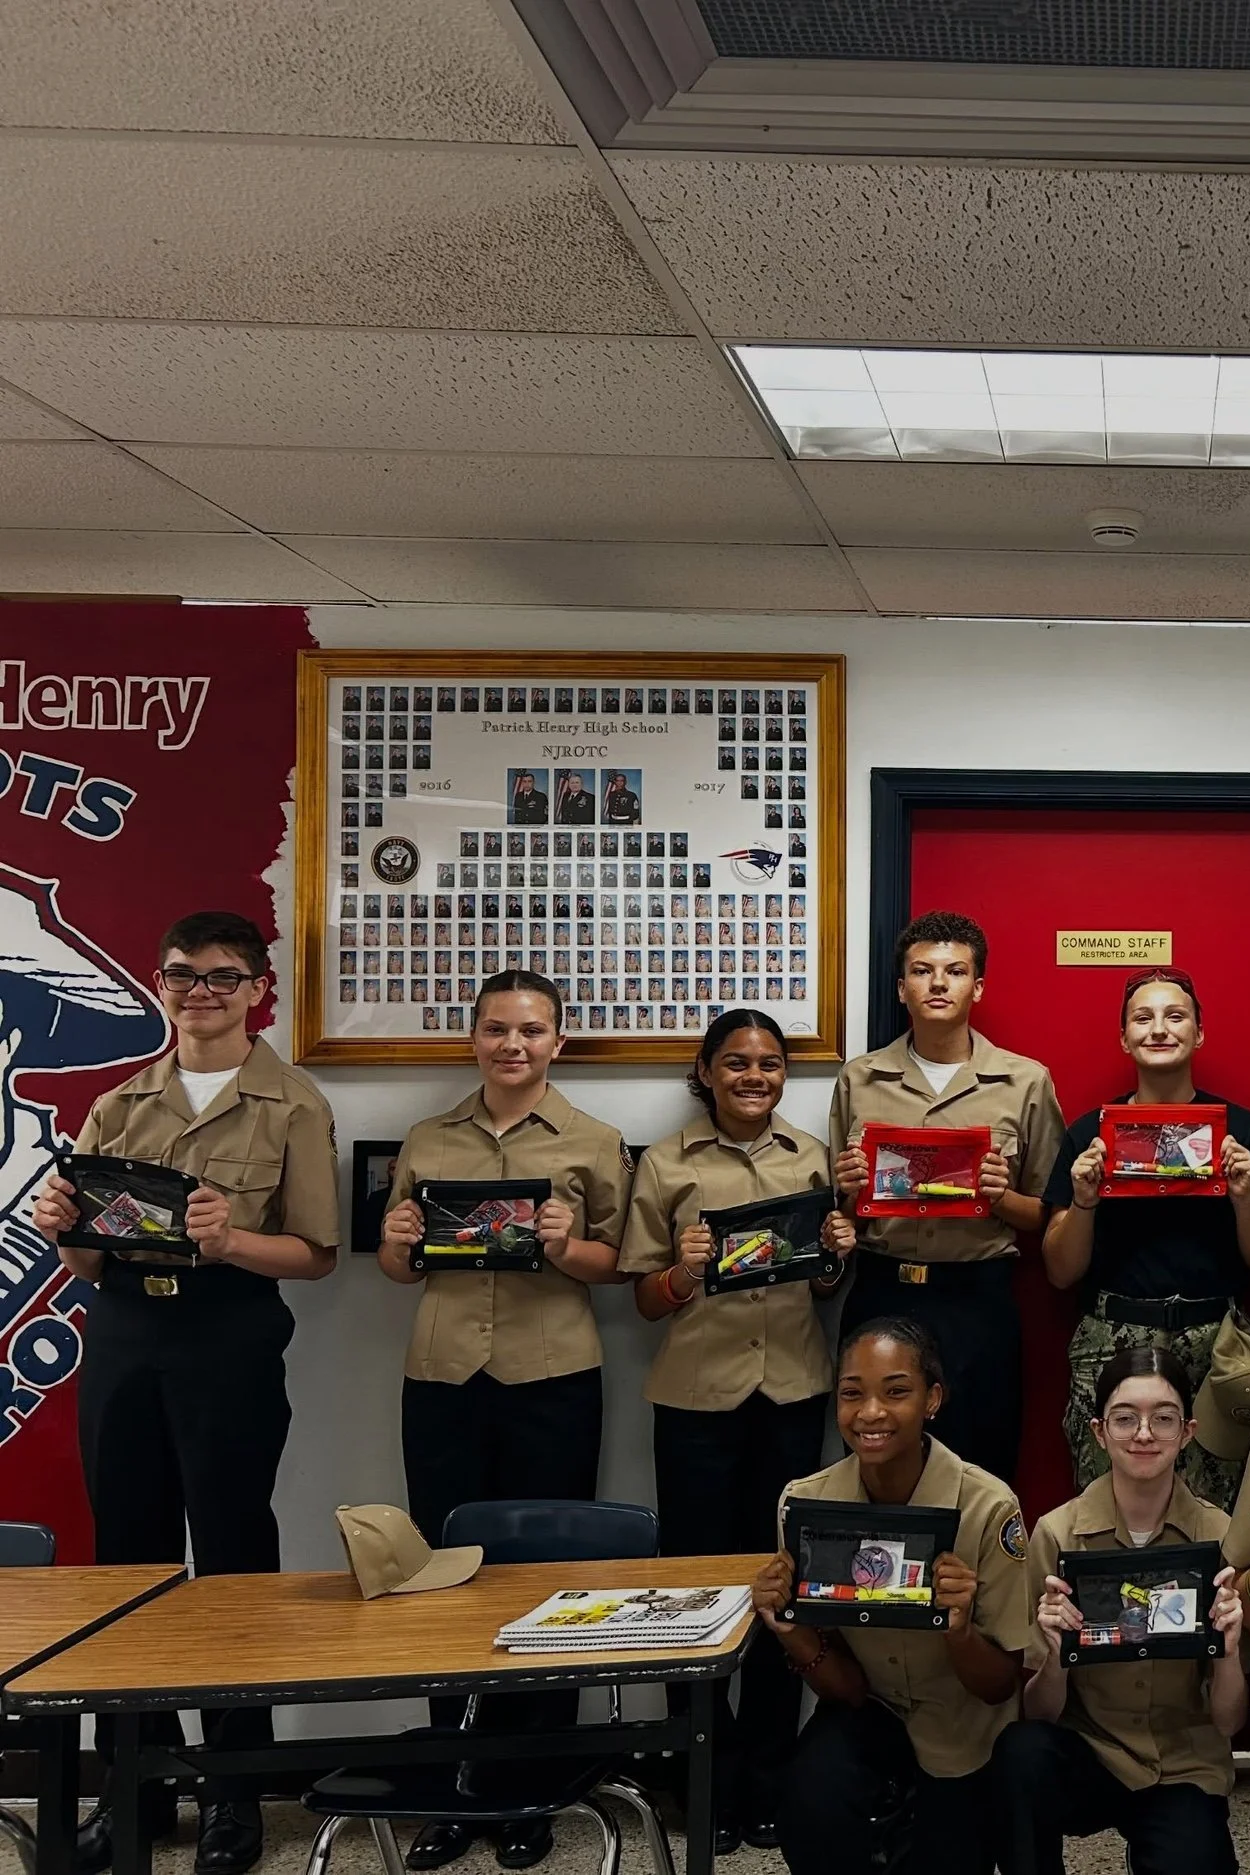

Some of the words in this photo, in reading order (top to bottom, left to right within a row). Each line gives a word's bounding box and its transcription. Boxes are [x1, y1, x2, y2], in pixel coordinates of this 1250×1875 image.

[481, 720, 534, 734] Patrick
[538, 721, 580, 736] Henry
[583, 721, 618, 737] High
[621, 721, 669, 735] School
[541, 745, 608, 761] NJROTC
[418, 779, 452, 791] 2016
[693, 782, 726, 795] 2017
[0, 749, 137, 842] TS
[1061, 937, 1121, 949] COMMAND
[1128, 937, 1167, 949] STAFF
[1080, 951, 1125, 959] RESTRICTED
[1128, 951, 1148, 959] AREA
